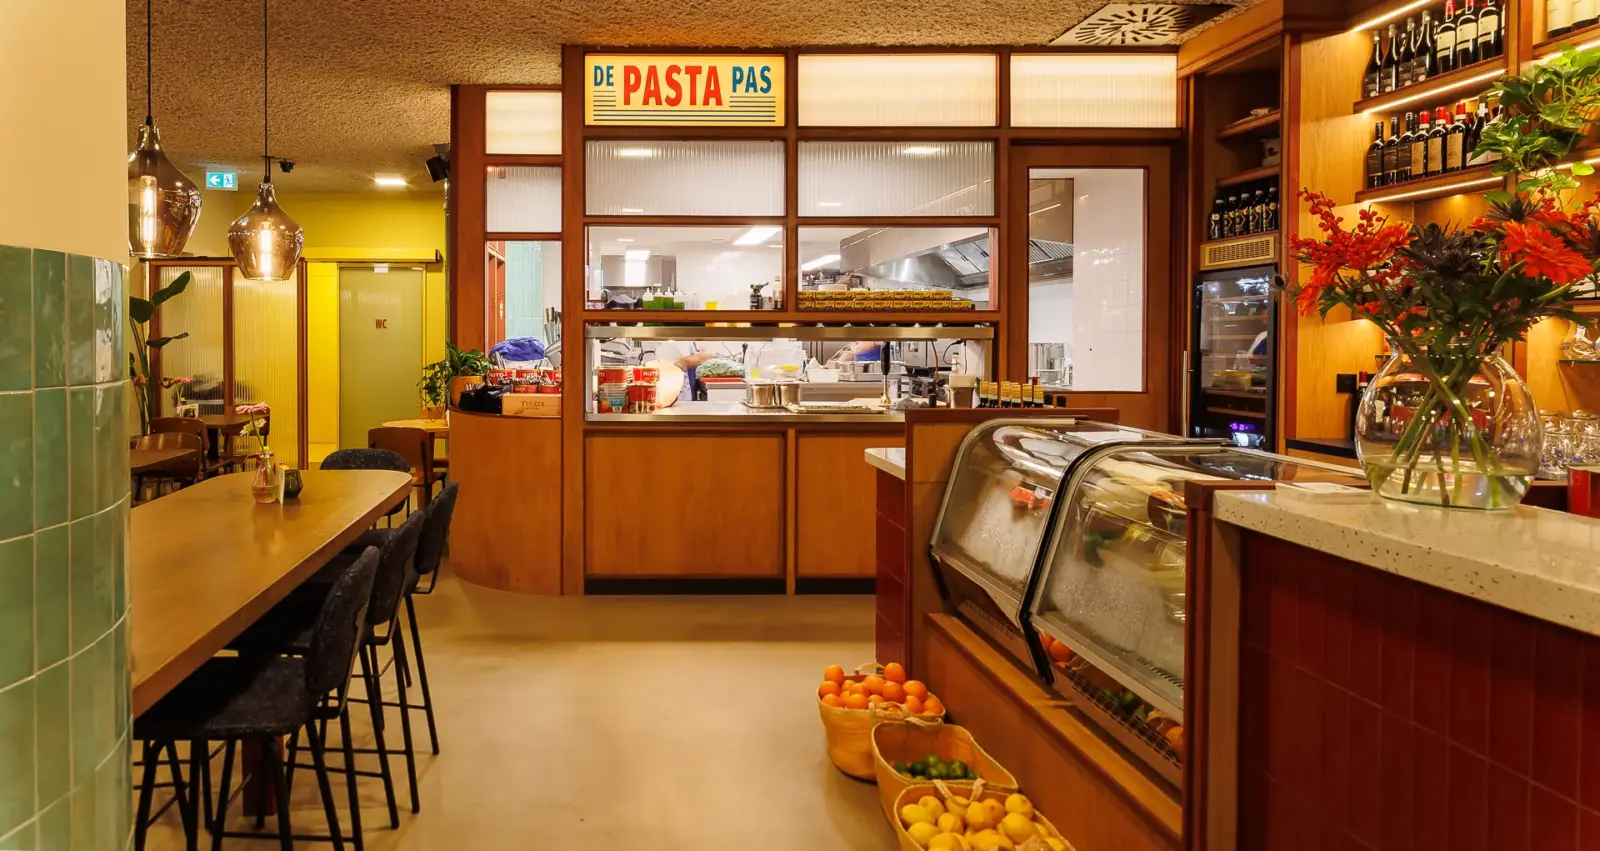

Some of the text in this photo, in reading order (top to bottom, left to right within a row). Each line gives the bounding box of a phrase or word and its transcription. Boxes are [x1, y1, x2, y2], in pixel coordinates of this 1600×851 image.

[593, 64, 772, 107] DE PASTA PAS
[375, 318, 387, 329] WC
